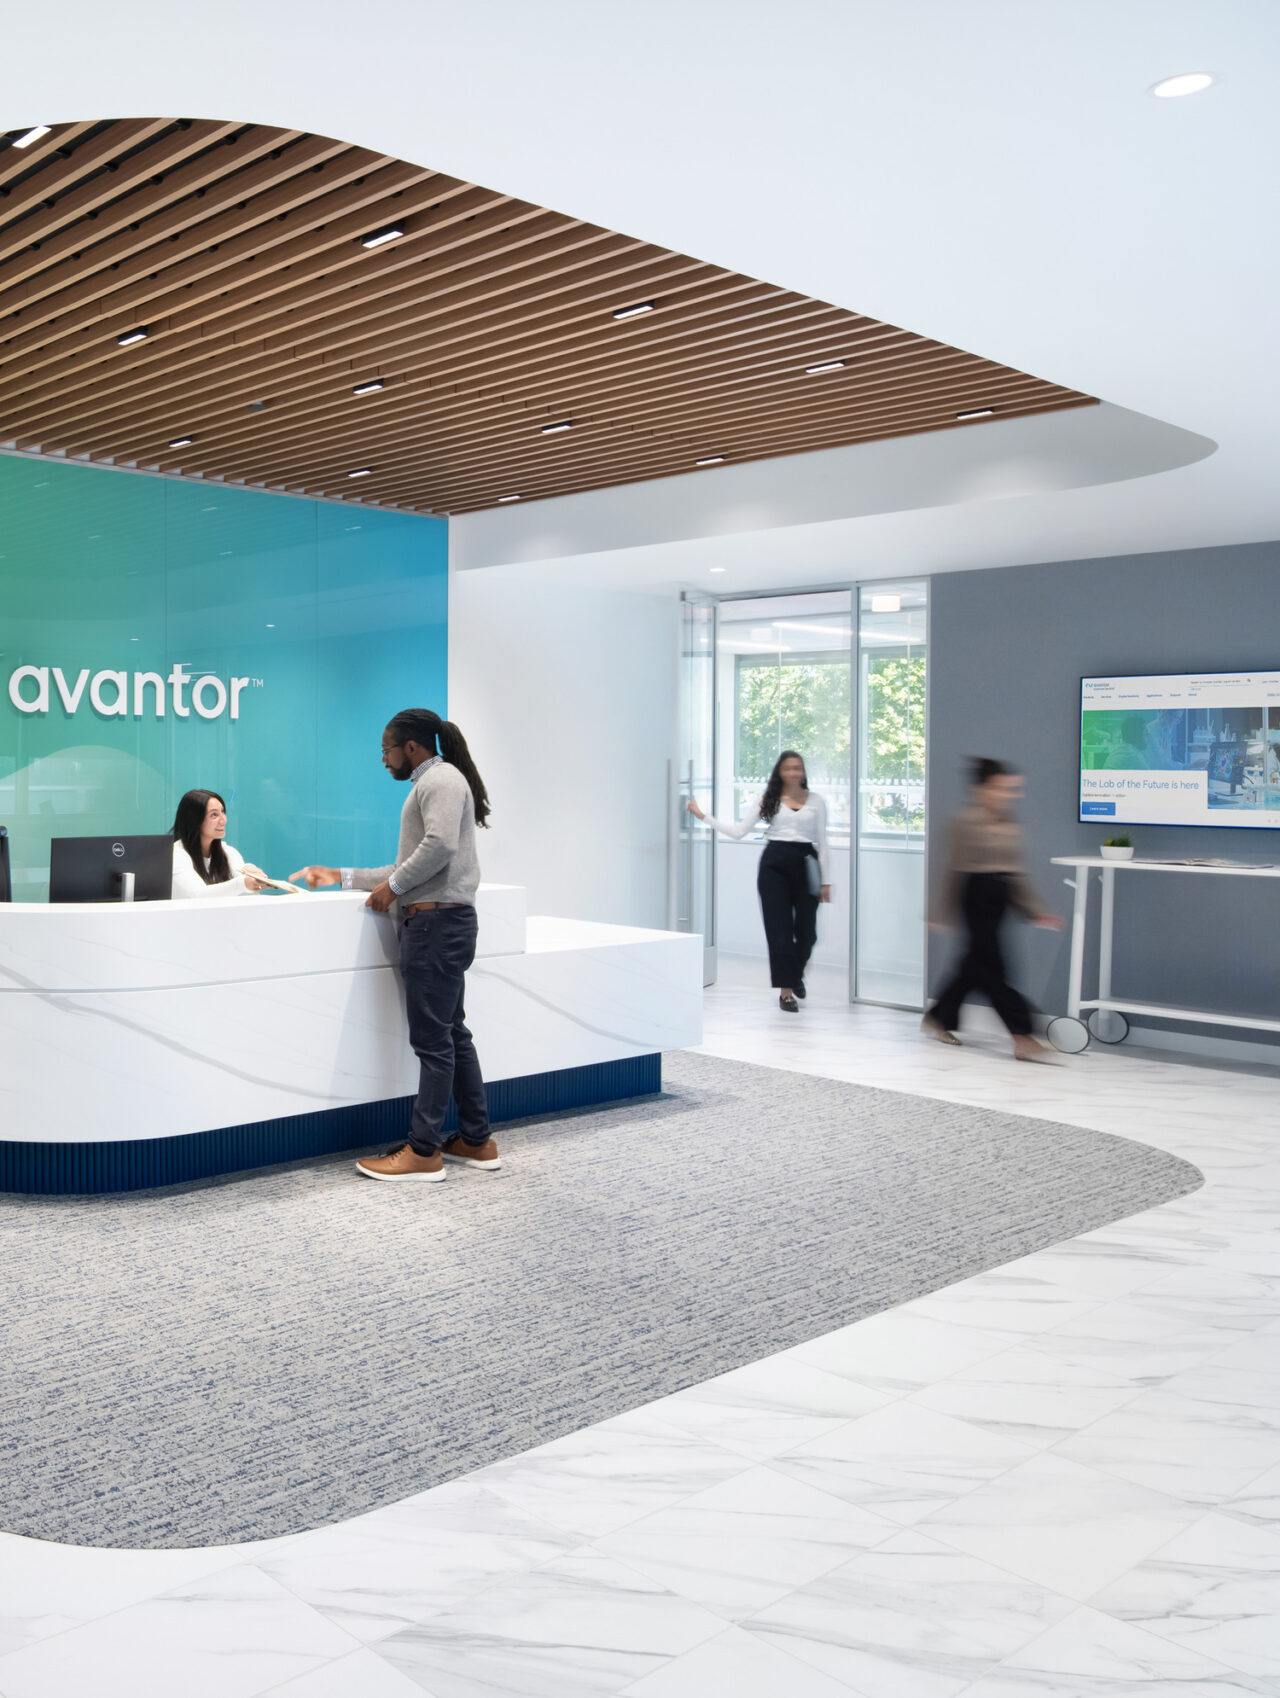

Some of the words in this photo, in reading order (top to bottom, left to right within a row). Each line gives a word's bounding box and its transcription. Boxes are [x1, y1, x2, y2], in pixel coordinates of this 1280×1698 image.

[8, 663, 250, 720] avantor
[1082, 779, 1097, 788] The
[1099, 779, 1115, 789] Lab
[1117, 779, 1125, 789] of
[1127, 779, 1141, 789] the
[1142, 779, 1169, 789] Future
[1171, 780, 1178, 789] is
[1180, 780, 1199, 790] here
